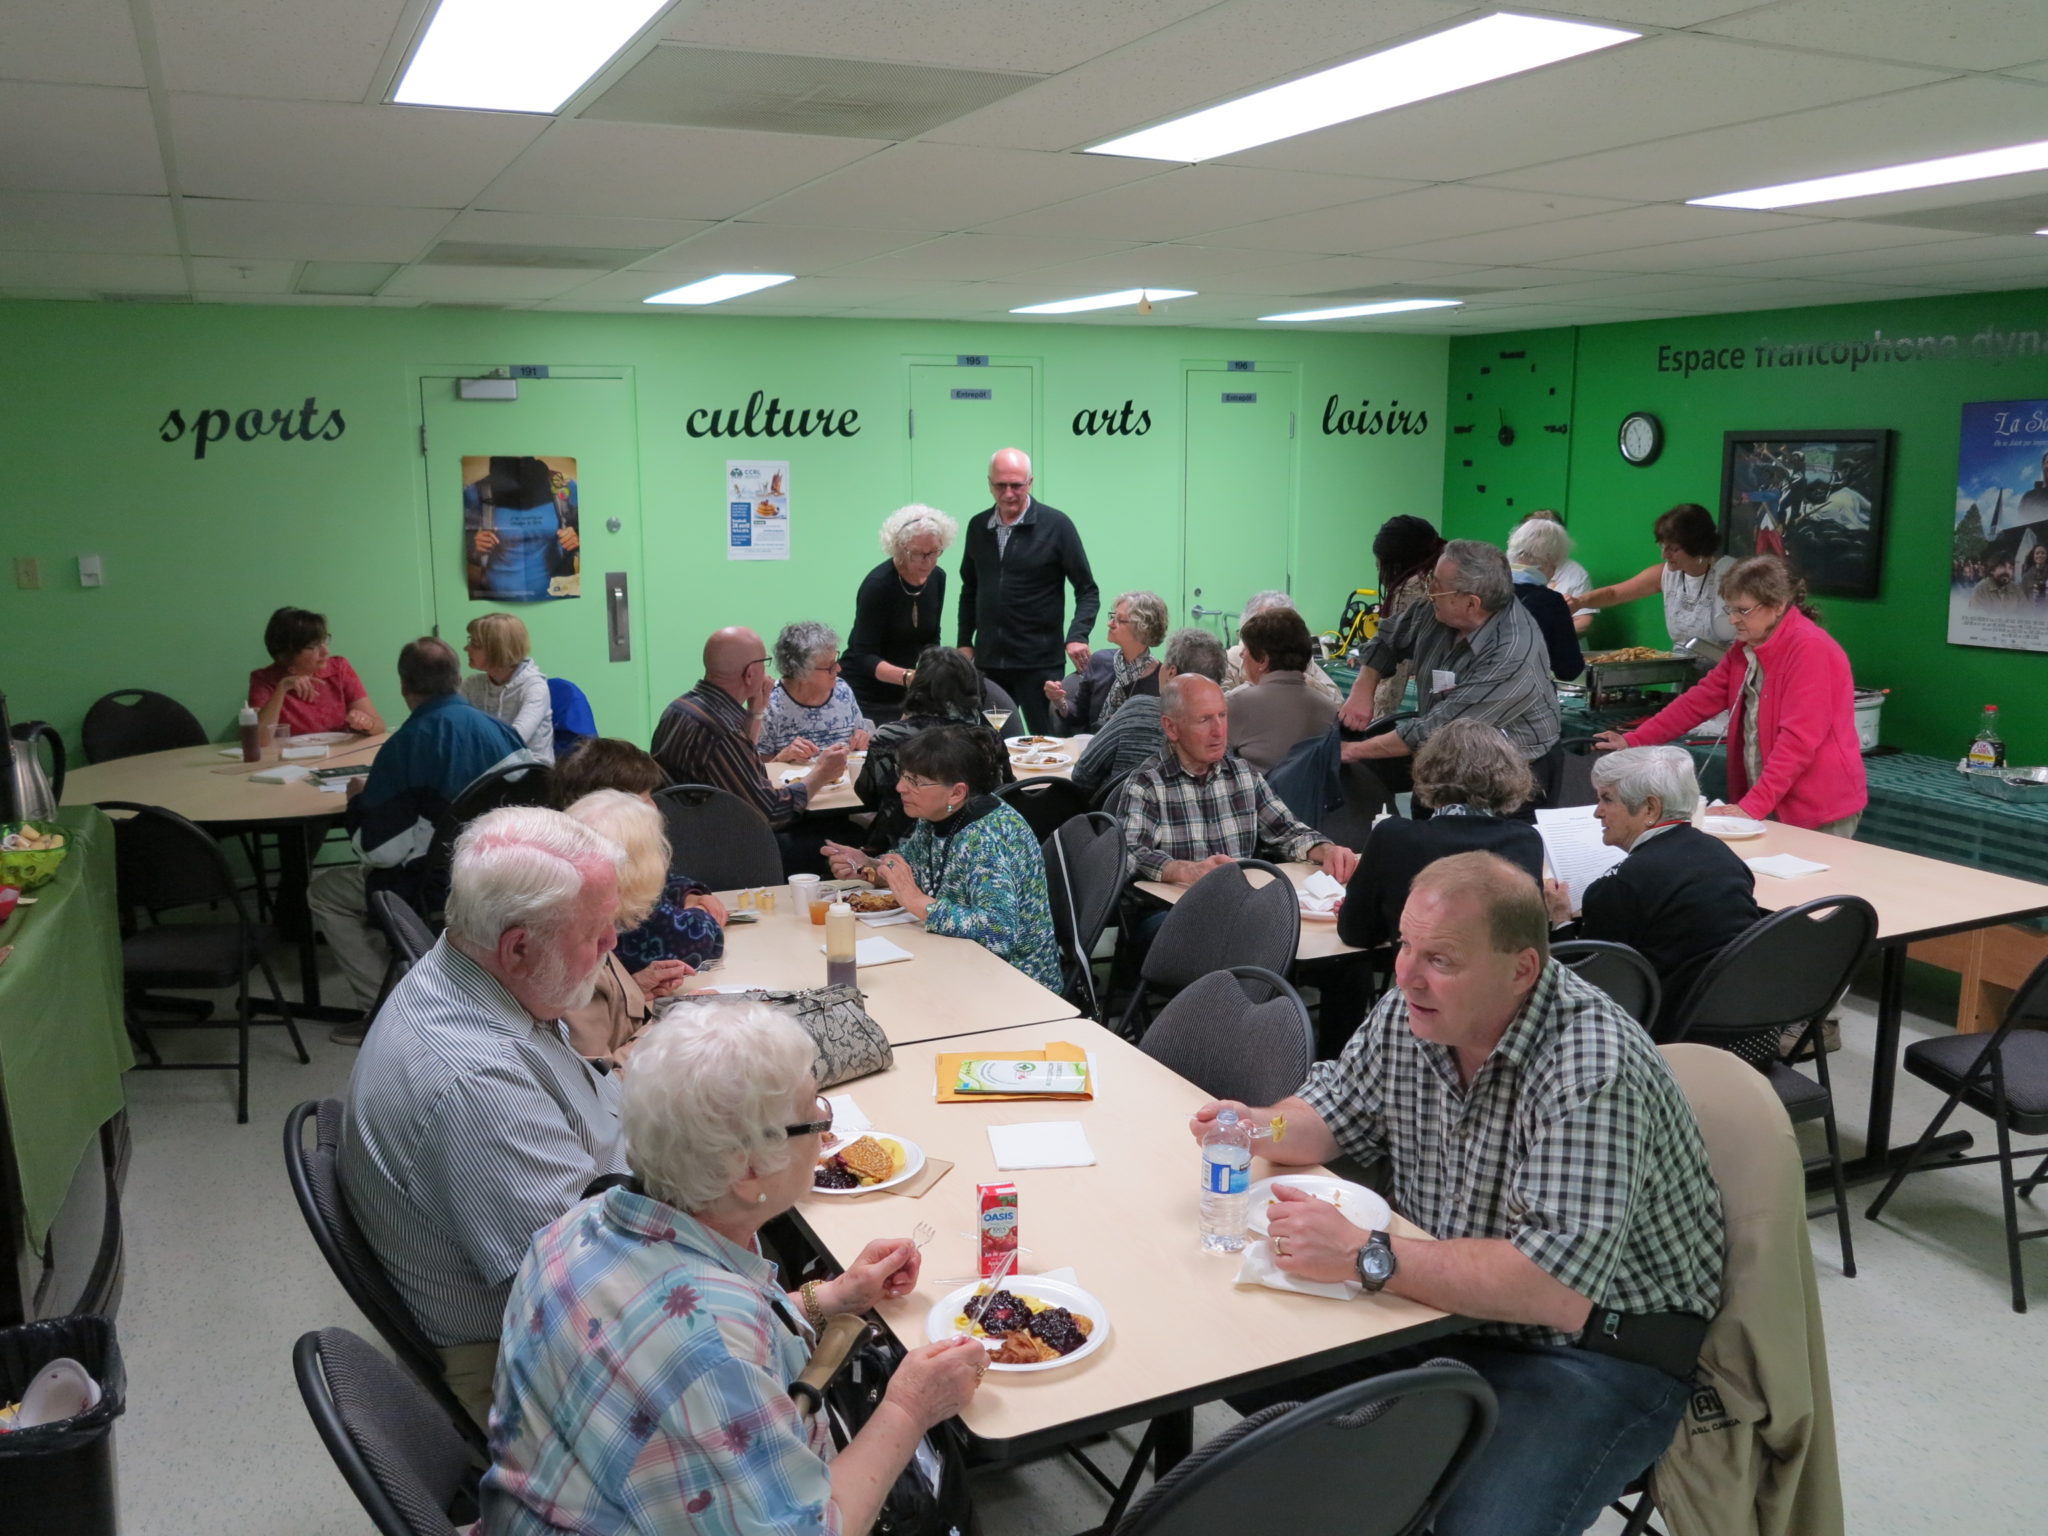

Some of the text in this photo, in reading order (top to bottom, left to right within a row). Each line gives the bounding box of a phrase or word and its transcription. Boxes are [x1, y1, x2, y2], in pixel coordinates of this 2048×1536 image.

[966, 356, 981, 366] 195
[1235, 361, 1248, 370] 196
[1658, 345, 1746, 378] Espace
[1755, 330, 1957, 371] francophone
[520, 367, 537, 376] 191
[160, 398, 346, 460] sports
[686, 390, 861, 438] culture
[1072, 400, 1152, 436] arts
[1323, 395, 1428, 435] loisirs
[1994, 411, 2020, 435] La
[983, 1212, 1014, 1221] OASIS
